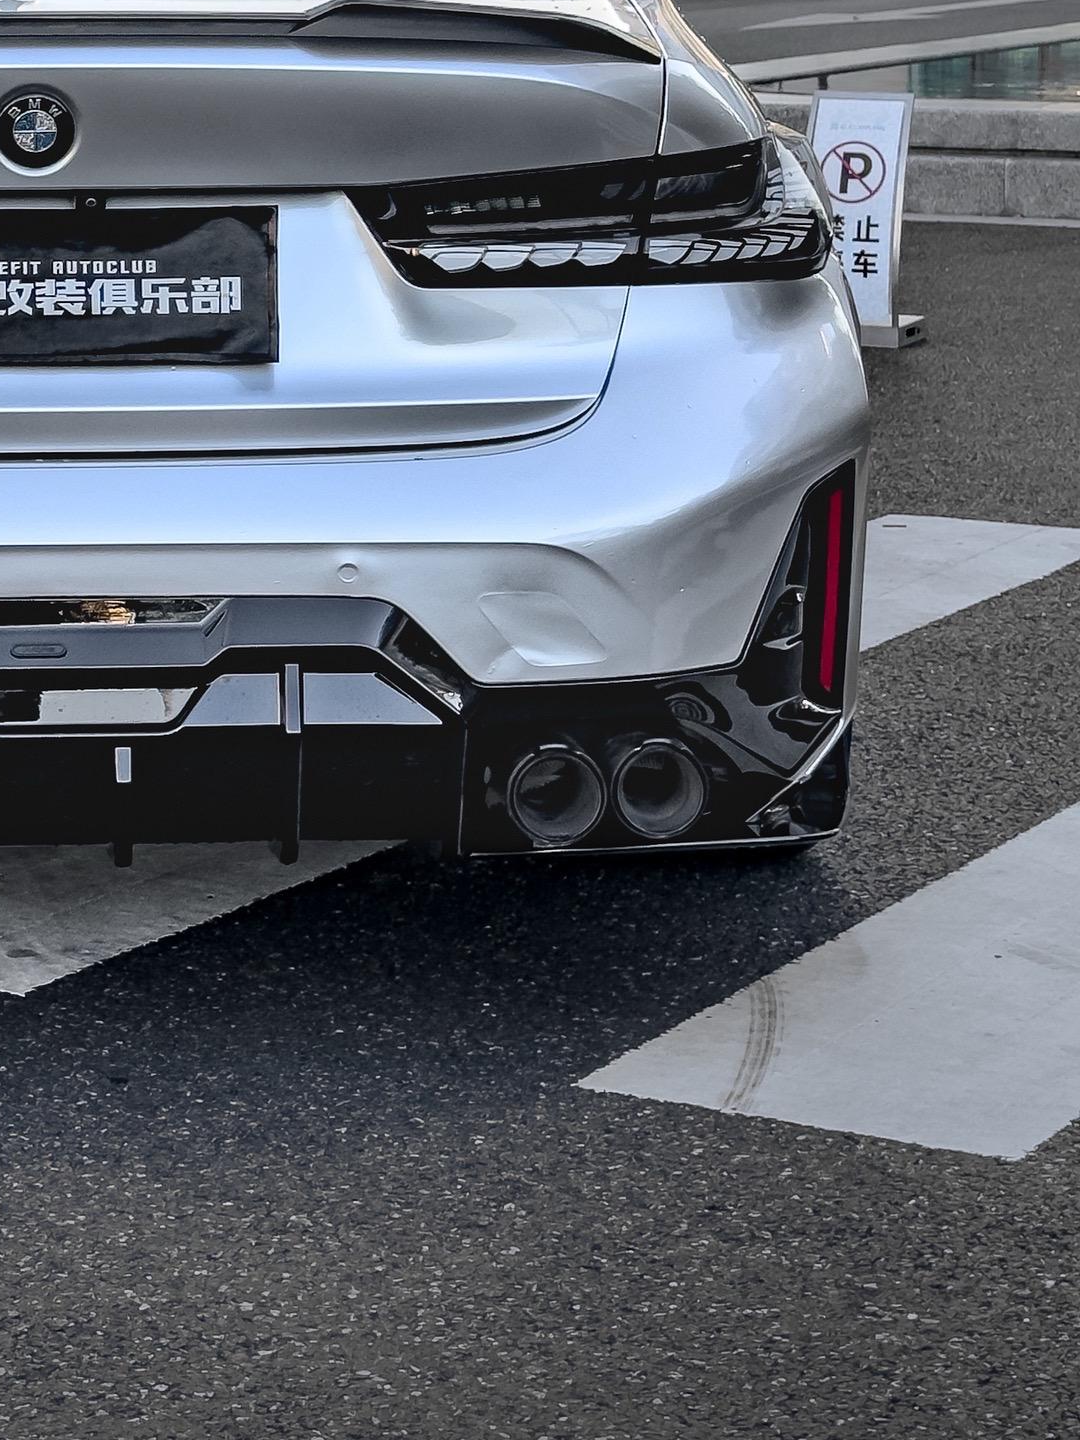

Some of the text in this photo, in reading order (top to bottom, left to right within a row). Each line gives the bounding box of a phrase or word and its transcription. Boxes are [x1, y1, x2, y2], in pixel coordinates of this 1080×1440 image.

[7, 98, 63, 119] BMW
[52, 260, 158, 275] AUTOCLUB
[836, 249, 879, 279] 车
